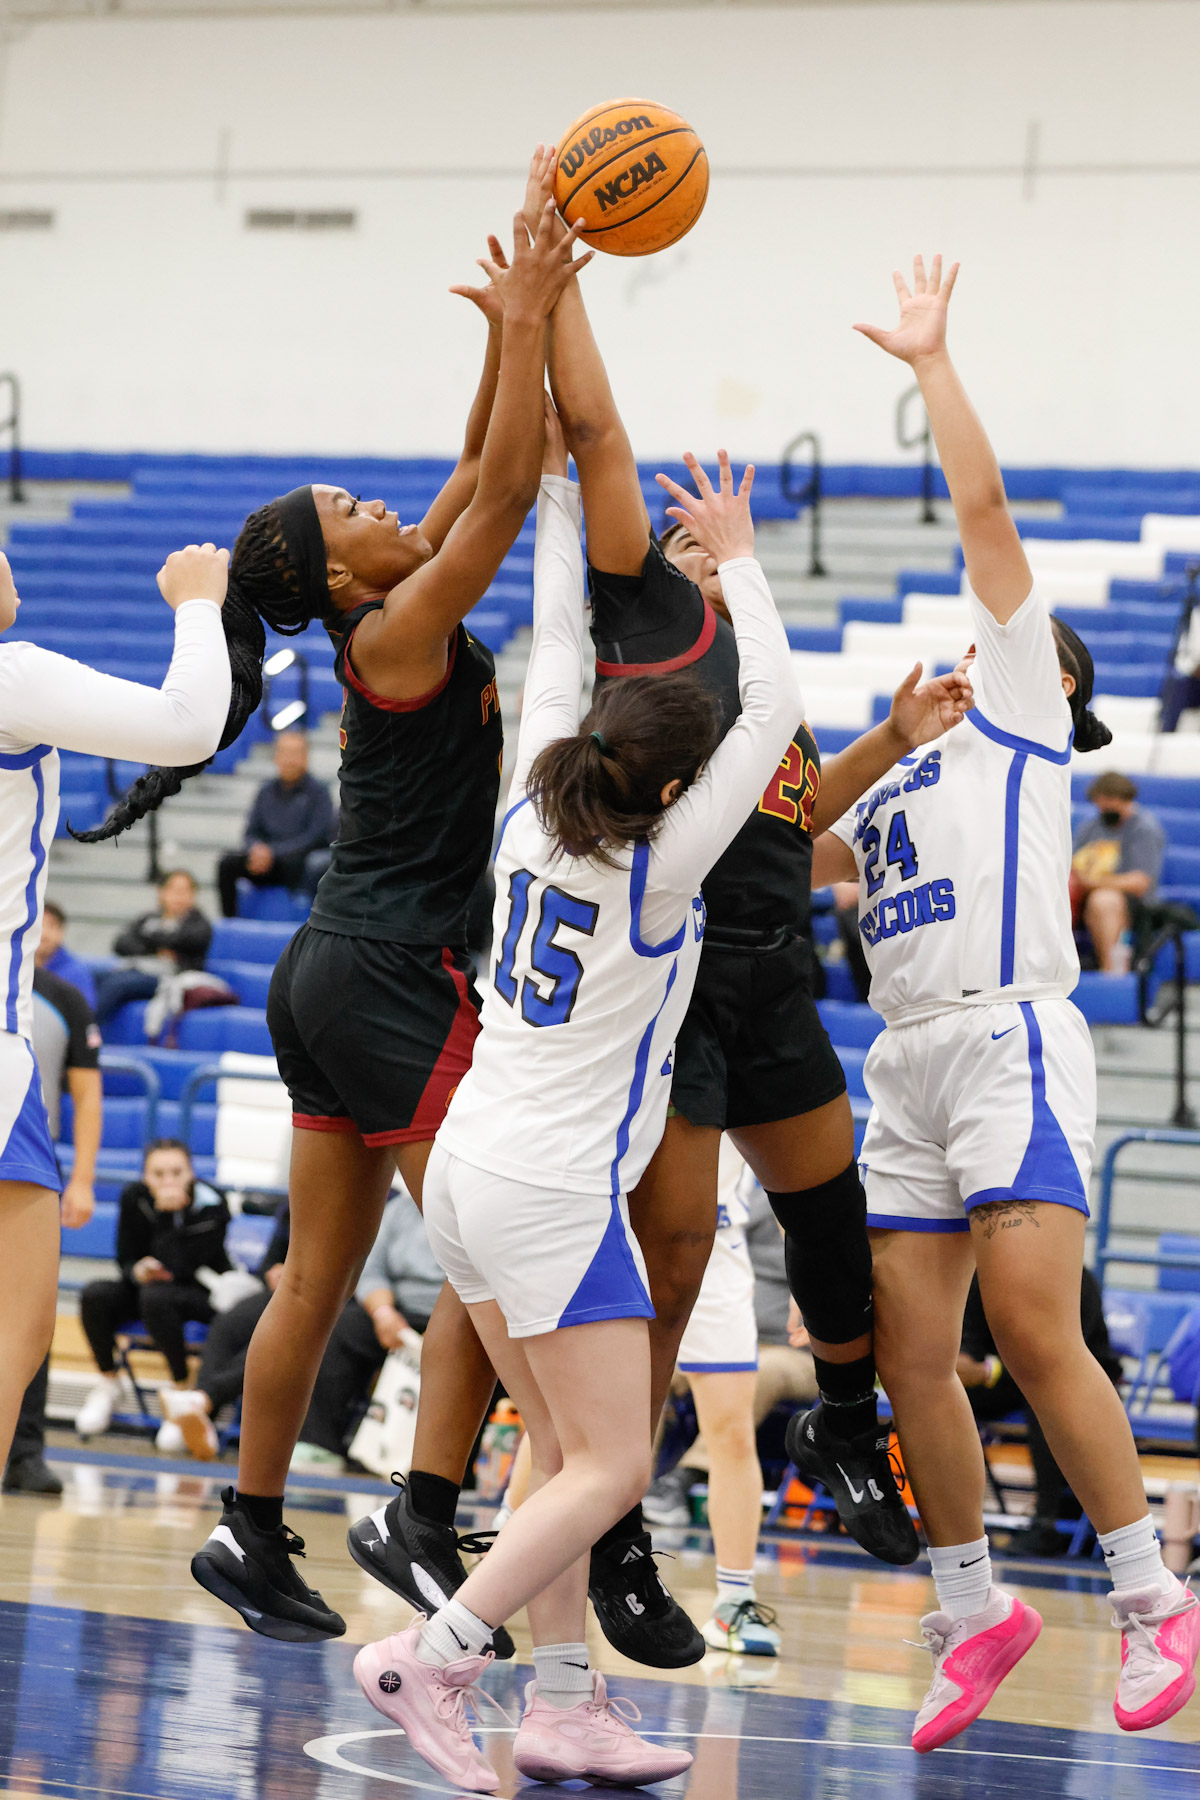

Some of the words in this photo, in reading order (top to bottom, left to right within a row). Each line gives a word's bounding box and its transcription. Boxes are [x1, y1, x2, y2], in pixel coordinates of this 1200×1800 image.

[559, 115, 655, 179] Wilson
[594, 151, 668, 212] NCAA
[604, 199, 632, 218] OFFICIAL
[632, 184, 652, 200] GAME
[653, 172, 671, 186] BALL
[862, 810, 919, 899] 24
[494, 868, 600, 1028] 15
